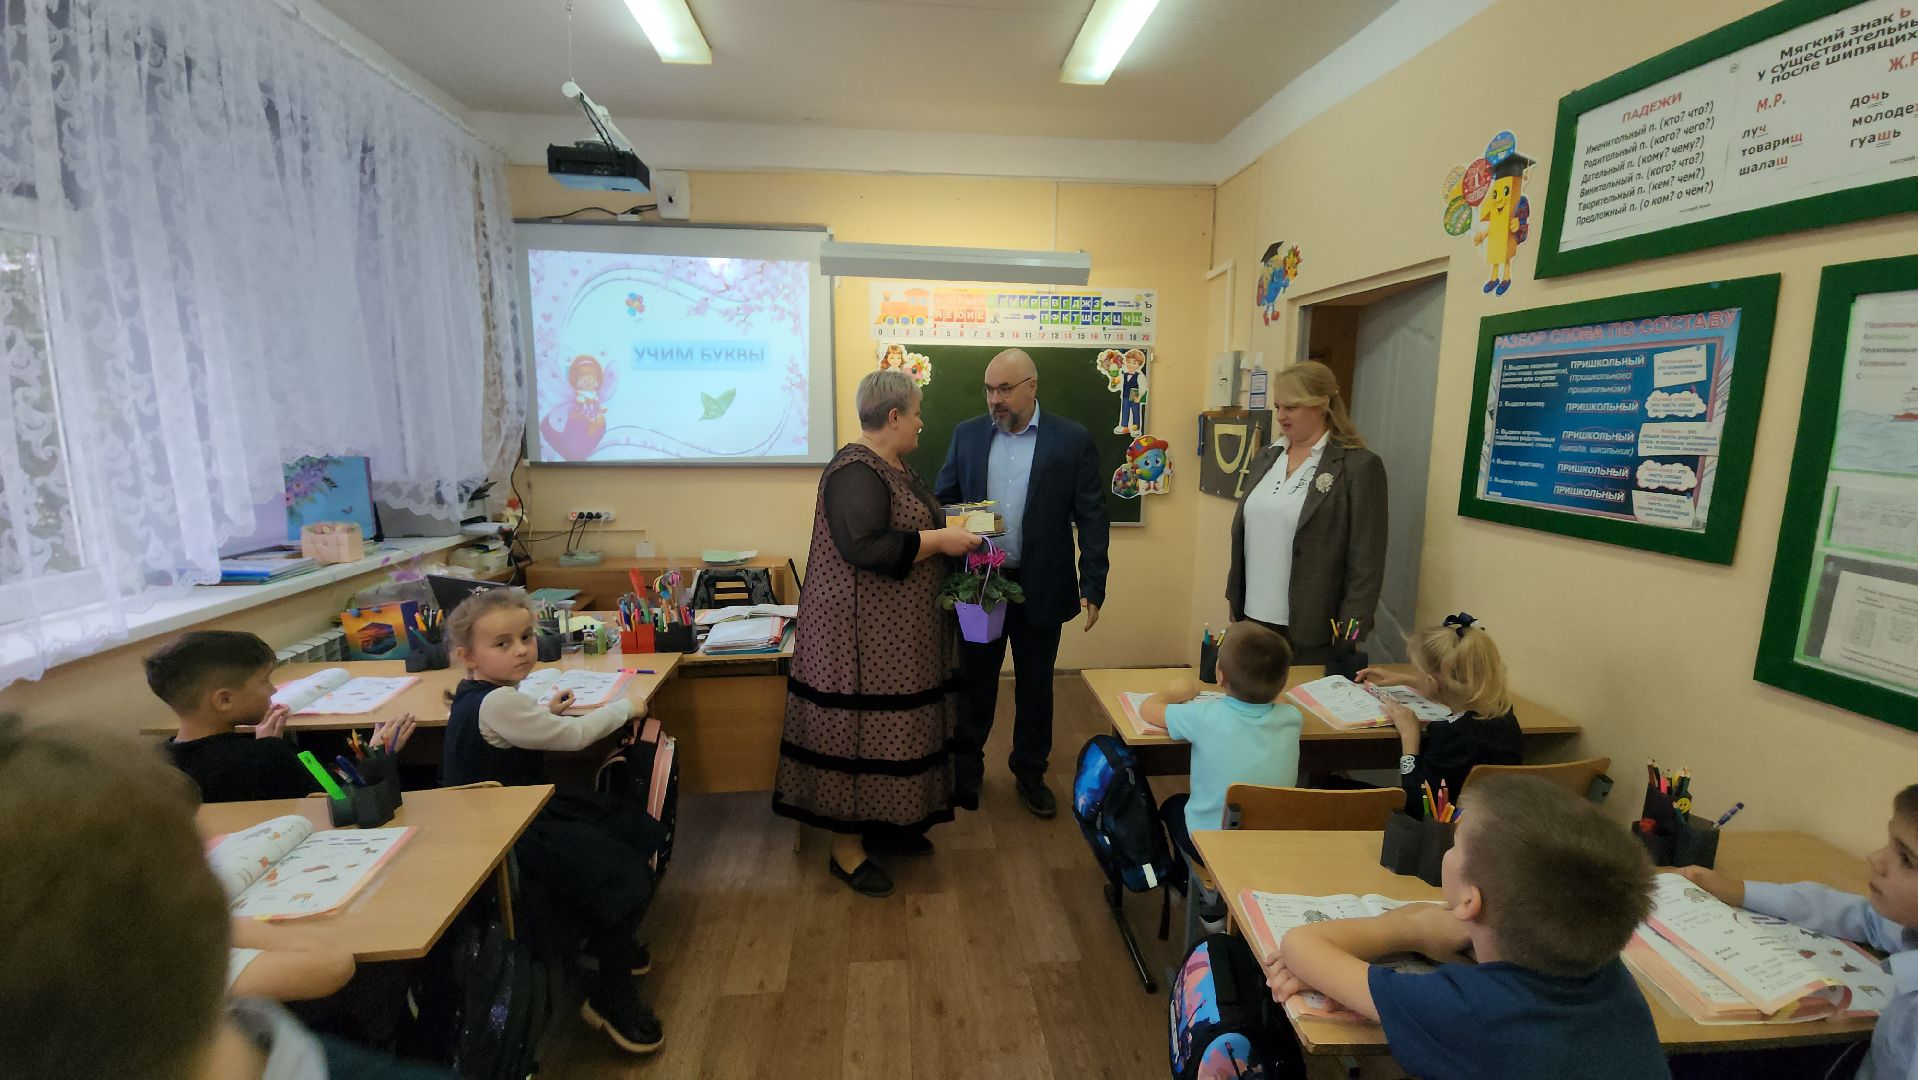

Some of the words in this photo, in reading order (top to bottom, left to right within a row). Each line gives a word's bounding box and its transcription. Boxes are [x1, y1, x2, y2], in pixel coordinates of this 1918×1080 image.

[1780, 27, 1844, 60] Мягкий
[1850, 13, 1894, 36] знак
[1771, 61, 1820, 85] после
[1826, 30, 1918, 66] шипящих
[1758, 70, 1766, 82] у
[1622, 92, 1682, 124] ПАДЕЖИ
[1756, 93, 1786, 113] М.Р.
[1850, 90, 1890, 110] дочь
[1586, 124, 1646, 155] Именительный
[1649, 124, 1657, 132] п.
[1660, 111, 1685, 130] (кто?
[1688, 100, 1714, 117] что?)
[1742, 125, 1767, 139] луч
[1584, 142, 1637, 169] Родительный
[1640, 142, 1648, 150] п.
[1650, 128, 1681, 148] (кого?
[1684, 117, 1714, 134] чего?)
[1742, 133, 1803, 157] товарищ
[1850, 129, 1902, 148] гуашь
[1581, 161, 1625, 186] Дательный
[1627, 160, 1635, 168] п.
[1638, 148, 1670, 168] (кому?
[1672, 136, 1704, 153] чему?)
[1739, 156, 1788, 176] шалаш
[1580, 174, 1633, 198] Винительный
[1646, 160, 1676, 180] (кого?
[1679, 152, 1704, 167] что?)
[1578, 187, 1635, 212] Творительный
[1648, 176, 1675, 194] (кем?
[1678, 166, 1704, 182] чем?)
[1576, 204, 1626, 227] Предложный
[1640, 200, 1650, 212] (о
[1652, 191, 1674, 206] ком?
[1677, 192, 1682, 200] о
[1550, 326, 1602, 344] СЛОВА
[1609, 321, 1634, 337] ПО
[1641, 311, 1737, 334] СОСТАВУ
[634, 347, 693, 362] УЧИМ
[700, 347, 764, 362] БУКВЫ
[1570, 356, 1645, 369] ПРИШКОЛЬНЫЙ
[1566, 402, 1640, 412] ПРИШКОЛЬНЫЙ
[1562, 430, 1635, 442] ПРИШКОЛЬНЫЙ
[1557, 463, 1629, 477] ПРИШКОЛЬНЫЙ
[1553, 486, 1626, 500] ПРИШКОЛЬНЫЙ
